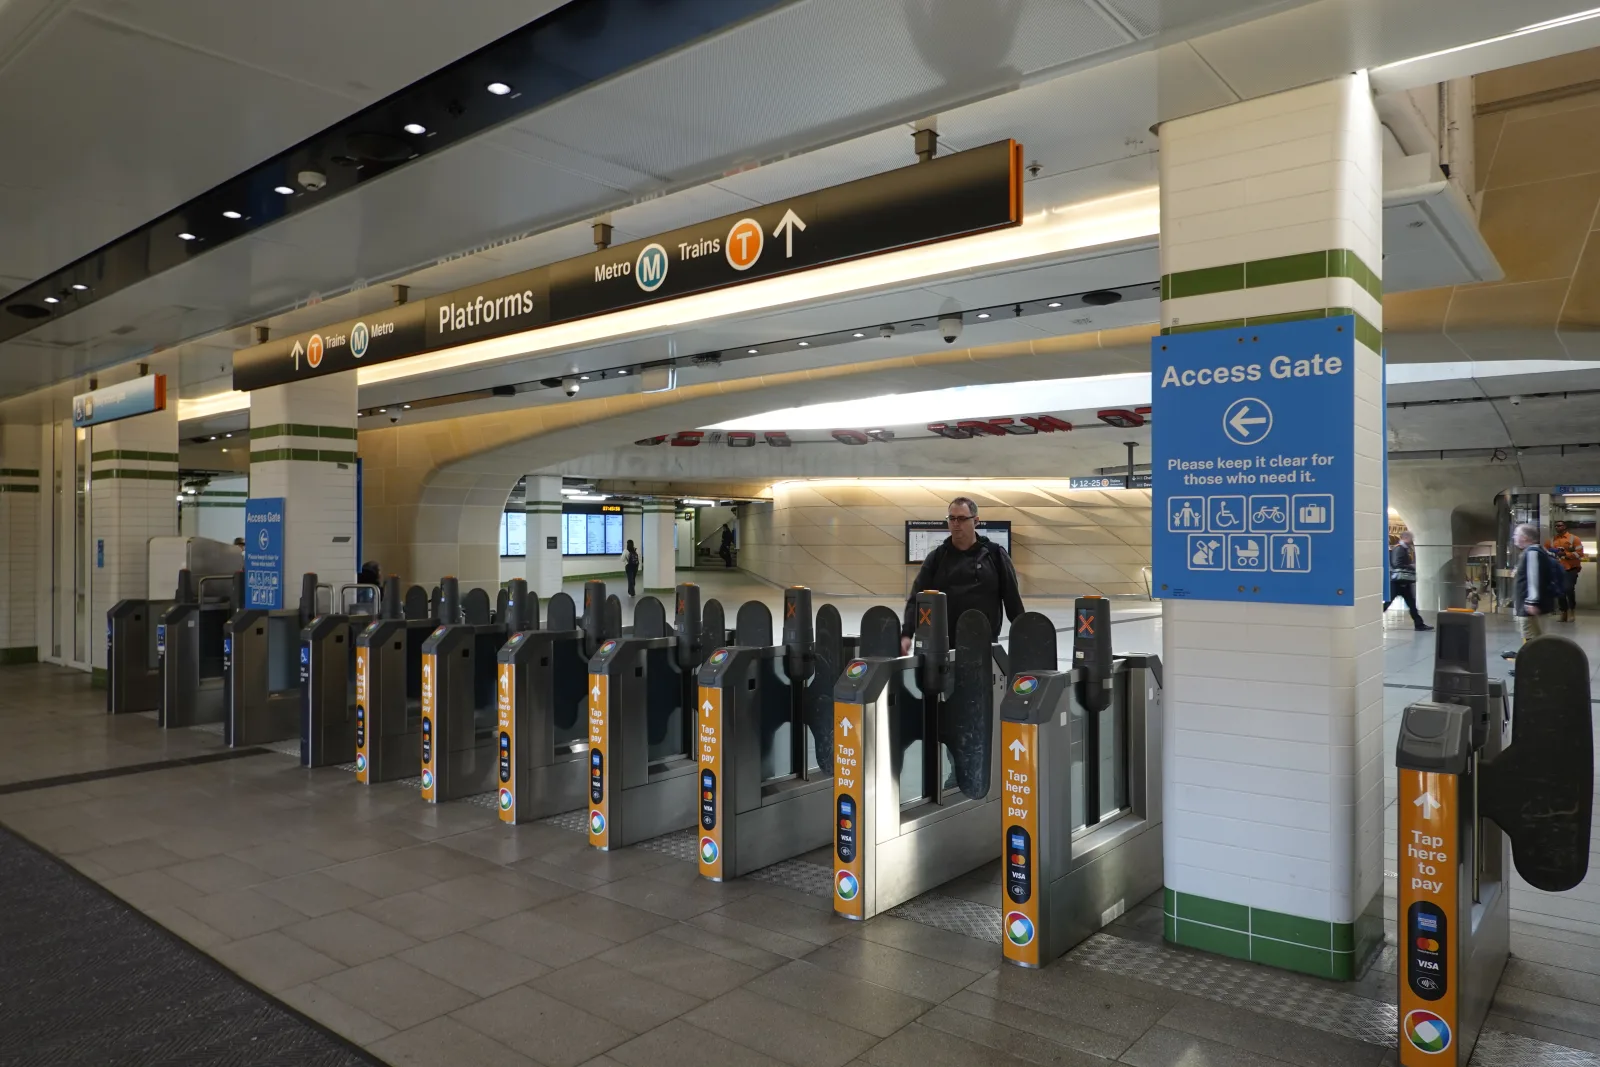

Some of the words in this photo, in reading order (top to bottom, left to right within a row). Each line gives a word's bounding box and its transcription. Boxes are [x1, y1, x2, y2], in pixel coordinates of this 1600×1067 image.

[595, 262, 630, 282] Metro
[678, 238, 720, 261] Trains
[440, 290, 533, 334] Platforms
[325, 334, 346, 349] Trains
[371, 322, 394, 338] Metro
[1161, 365, 1261, 388] Access
[1270, 353, 1342, 379] Gate
[1168, 459, 1213, 471] Please
[1217, 457, 1252, 471] keep
[1255, 456, 1266, 468] it
[1270, 455, 1308, 467] clear
[1312, 454, 1334, 466] for
[1184, 474, 1222, 485] those
[1227, 472, 1256, 484] who
[1260, 470, 1296, 483] need
[1300, 470, 1316, 482] it.
[247, 513, 267, 523] Access
[268, 512, 281, 522] Gate
[591, 708, 602, 718] Tap
[590, 716, 603, 725] here
[592, 726, 600, 734] to
[701, 724, 715, 735] Tap
[591, 734, 602, 744] pay
[700, 733, 716, 743] here
[704, 744, 712, 752] to
[838, 744, 855, 757] Tap
[701, 754, 715, 764] pay
[836, 754, 857, 766] here
[841, 766, 851, 775] to
[1008, 769, 1028, 783] Tap
[838, 778, 855, 788] pay
[1005, 781, 1030, 794] here
[1011, 795, 1023, 805] to
[1008, 807, 1028, 819] pay
[1411, 830, 1443, 848] Tap
[1408, 844, 1447, 862] here
[1418, 862, 1435, 875] to
[1011, 871, 1025, 880] VISA
[1411, 877, 1443, 893] pay
[1416, 959, 1438, 970] VISA
